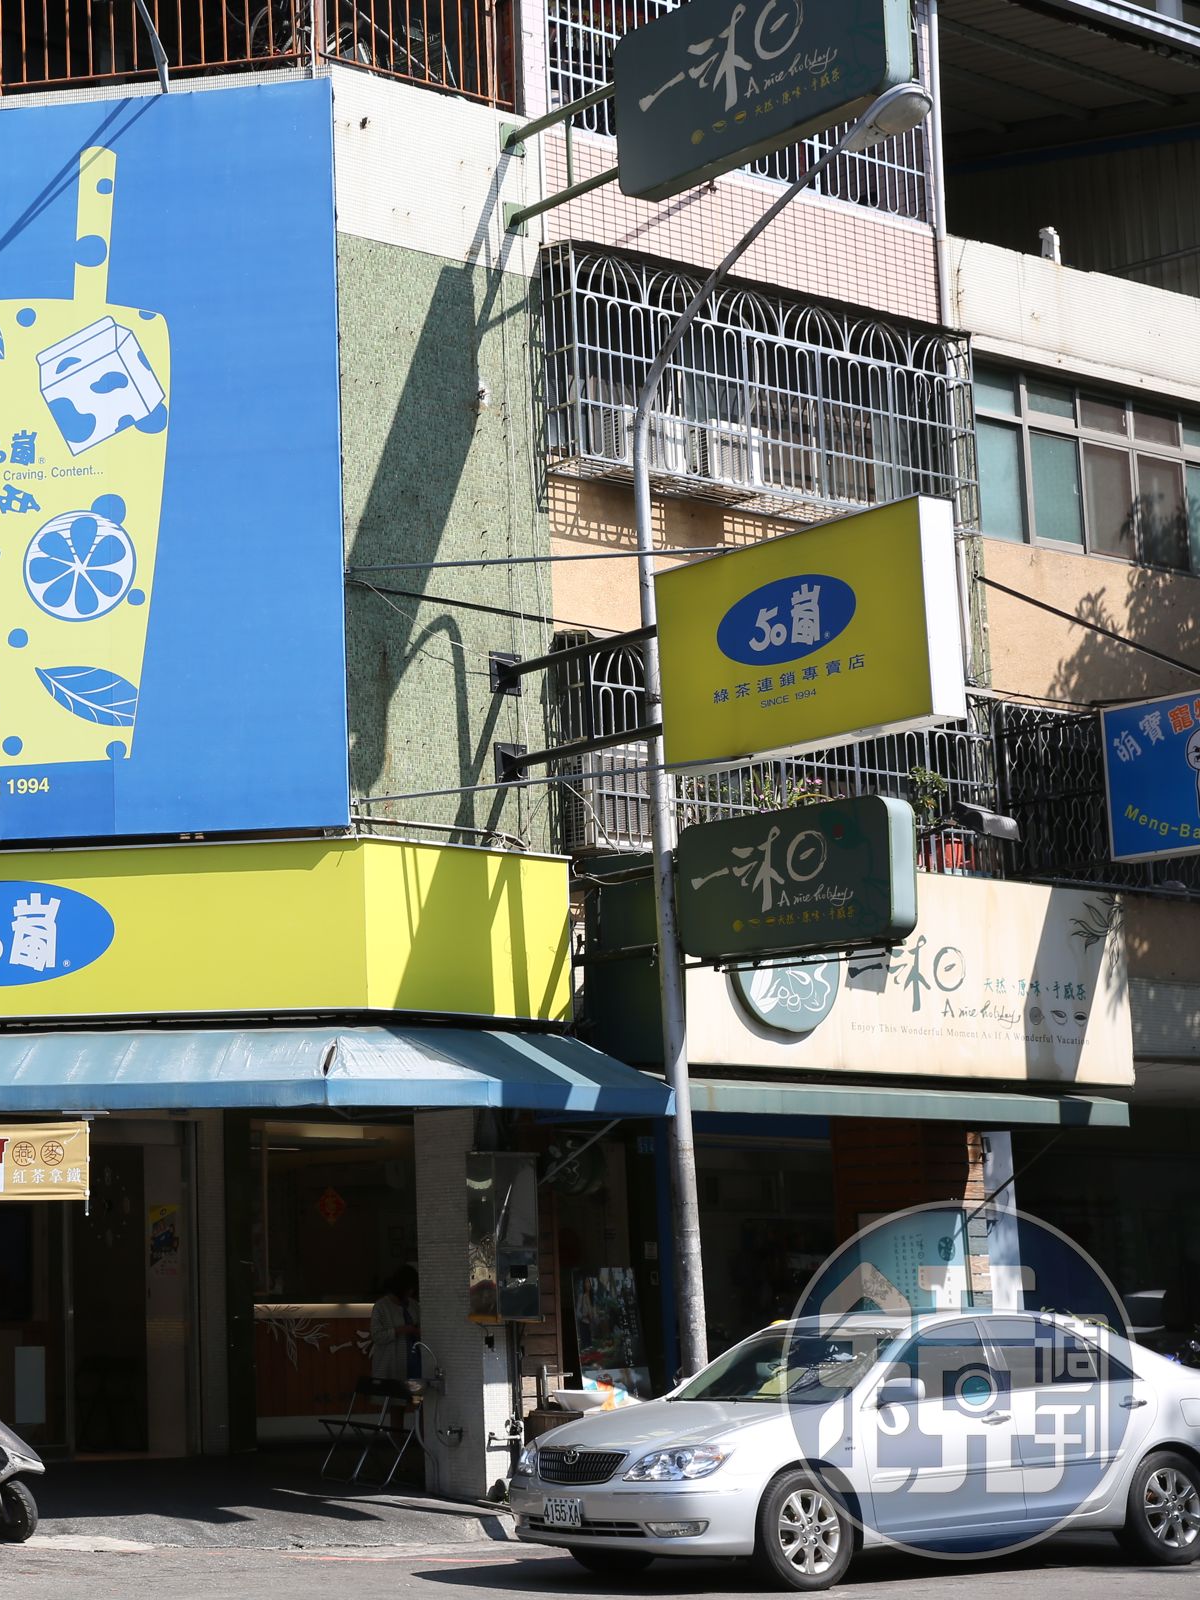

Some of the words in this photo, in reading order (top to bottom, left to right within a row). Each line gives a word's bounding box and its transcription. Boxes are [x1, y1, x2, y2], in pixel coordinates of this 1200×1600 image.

[744, 76, 760, 98] A
[763, 70, 786, 91] nice
[787, 47, 838, 76] holiday
[3, 469, 47, 482] Craving.
[713, 654, 865, 704] 綠茶連鎖專賣店
[761, 694, 790, 709] SINCE
[795, 688, 817, 701] 1994
[6, 777, 49, 795] 1994
[777, 890, 790, 907] A
[793, 893, 811, 905] nice
[813, 883, 854, 906] holiday
[941, 998, 955, 1018] A
[959, 1006, 977, 1019] nice
[980, 1000, 1021, 1029] holiday
[851, 1022, 875, 1033] Enjoy
[879, 1023, 897, 1033] This
[901, 1025, 943, 1037] Wonderful
[947, 1028, 978, 1039] Moment
[981, 1032, 992, 1040] As
[995, 1032, 1002, 1040] If
[1005, 1033, 1011, 1041] A
[1014, 1033, 1054, 1043] Wonderful
[1057, 1035, 1090, 1045] Vacation
[13, 1143, 63, 1165] 燕麥
[12, 1168, 81, 1184] 紅茶拿鐵
[543, 1503, 580, 1523] 4155-XA
